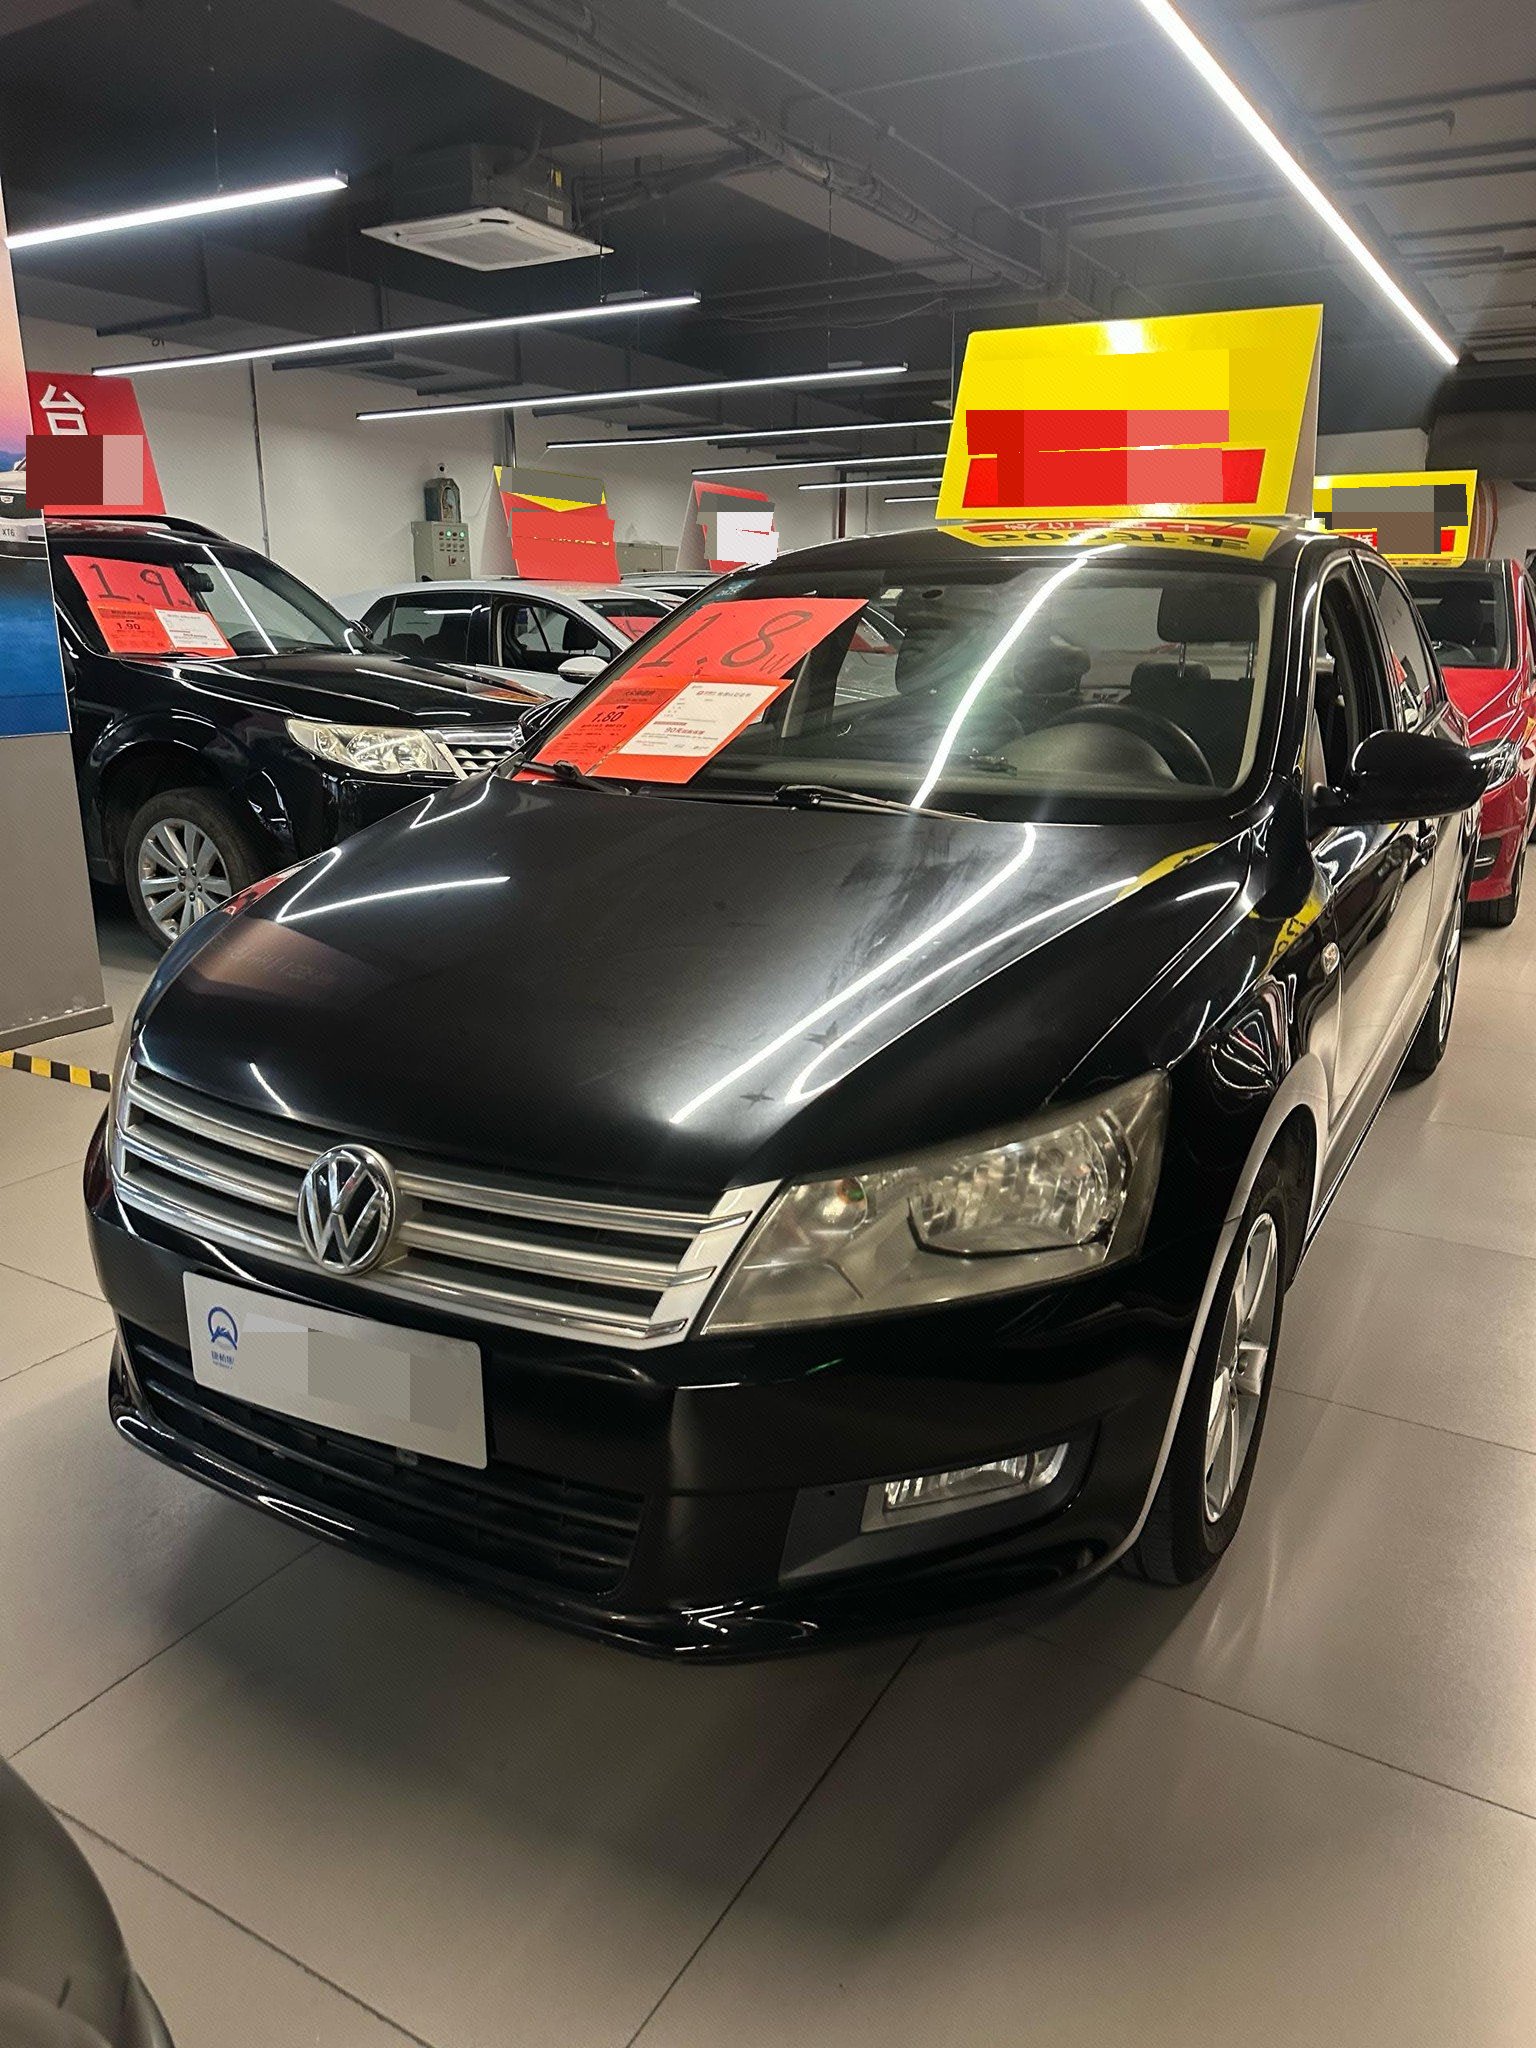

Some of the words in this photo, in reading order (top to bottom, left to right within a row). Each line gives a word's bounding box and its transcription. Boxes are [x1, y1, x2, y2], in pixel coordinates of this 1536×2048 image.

[39, 384, 89, 435] 台
[2, 528, 15, 537] XT6
[591, 711, 625, 723] 1.80
